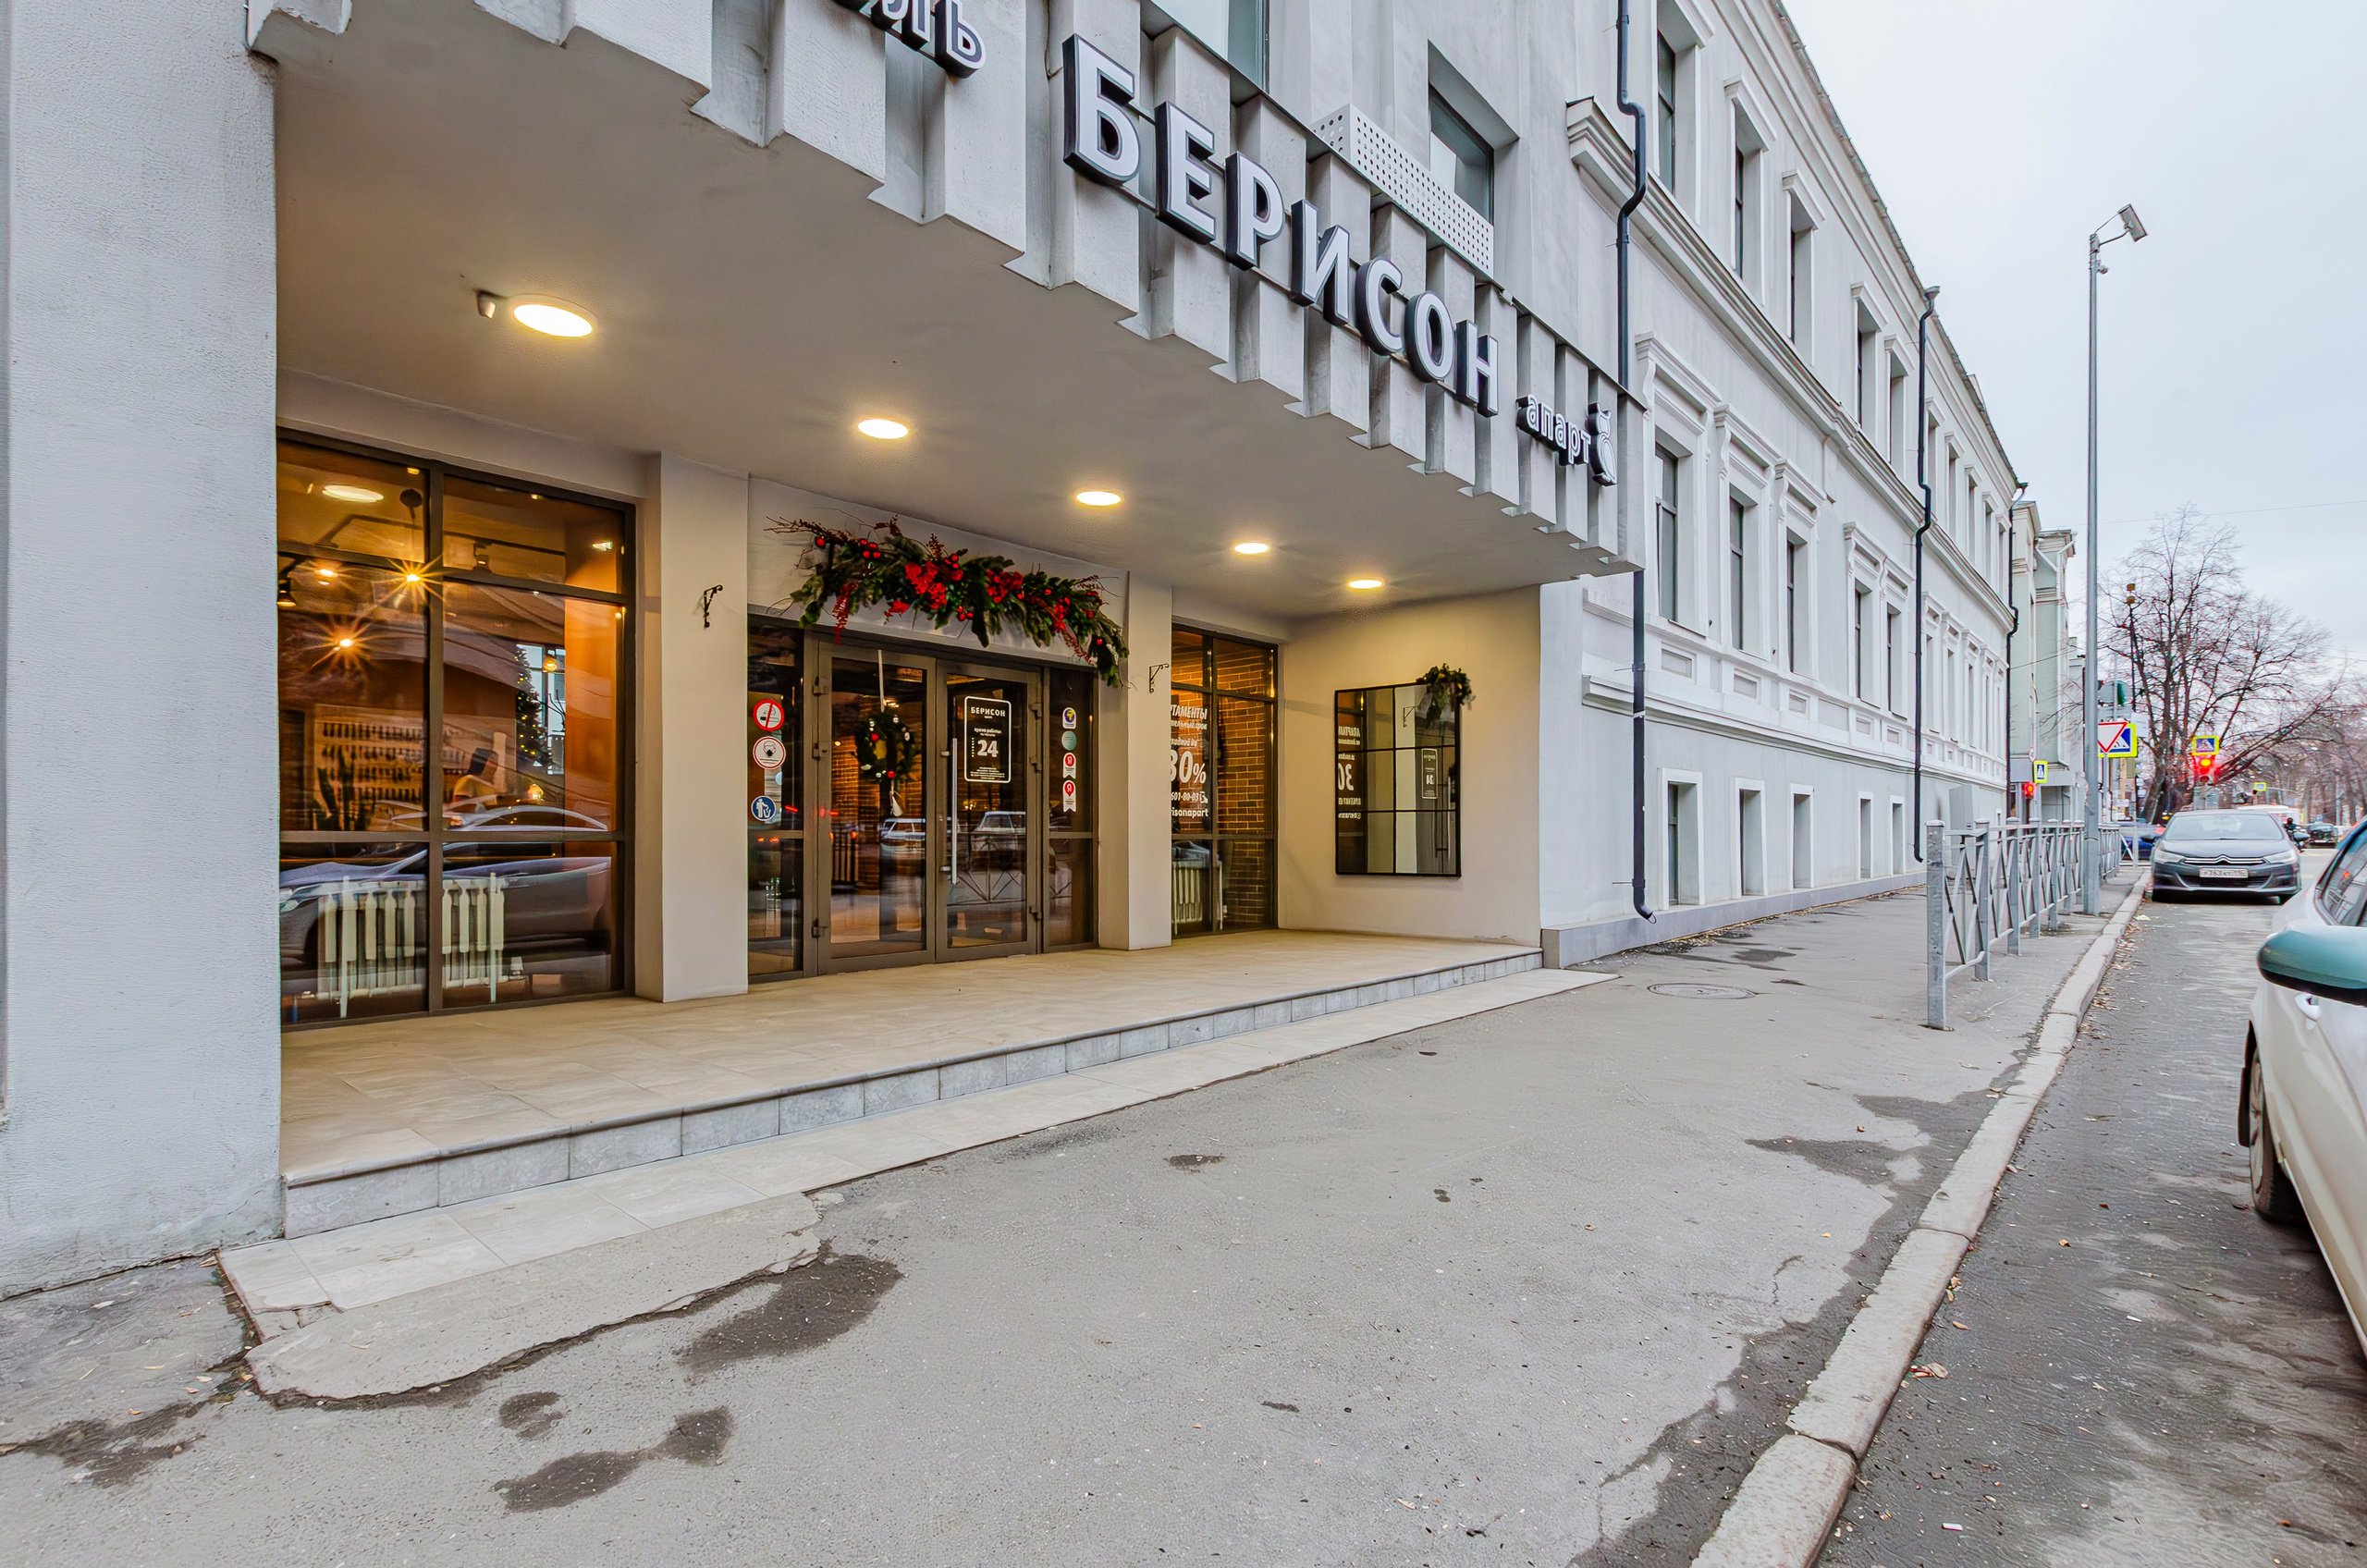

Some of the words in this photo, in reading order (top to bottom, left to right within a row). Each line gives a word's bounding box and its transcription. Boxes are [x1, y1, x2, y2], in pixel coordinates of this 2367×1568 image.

[1062, 33, 1499, 418] БЕРИСОН
[1516, 394, 1591, 466] апарт
[971, 706, 1005, 717] БЕРИСОН
[977, 740, 999, 757] 24
